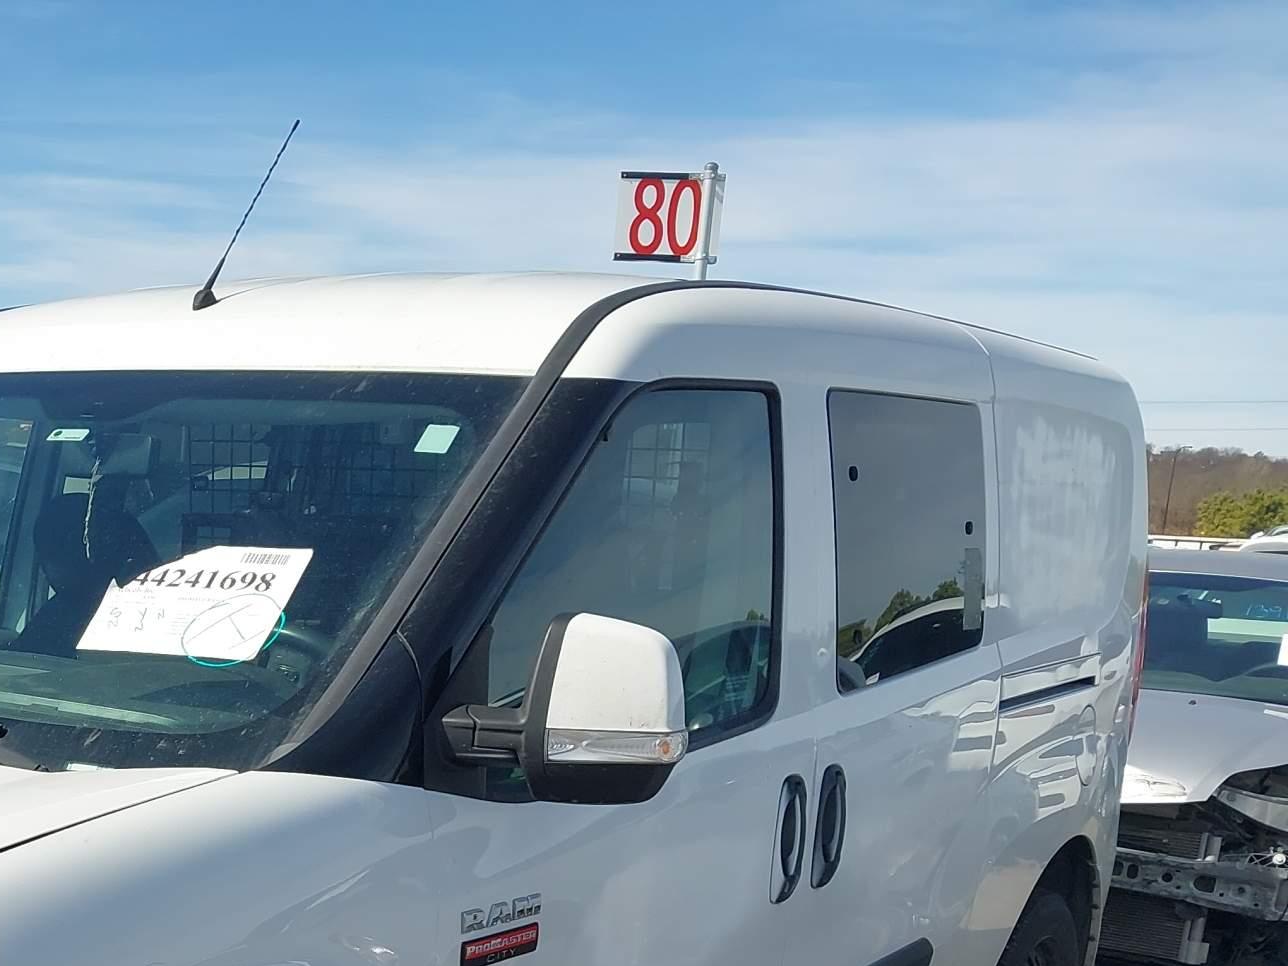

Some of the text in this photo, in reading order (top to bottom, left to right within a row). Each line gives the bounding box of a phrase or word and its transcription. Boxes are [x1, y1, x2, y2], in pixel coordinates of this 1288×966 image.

[629, 177, 702, 256] 80
[460, 893, 542, 935] RAM
[486, 947, 517, 963] CITY
